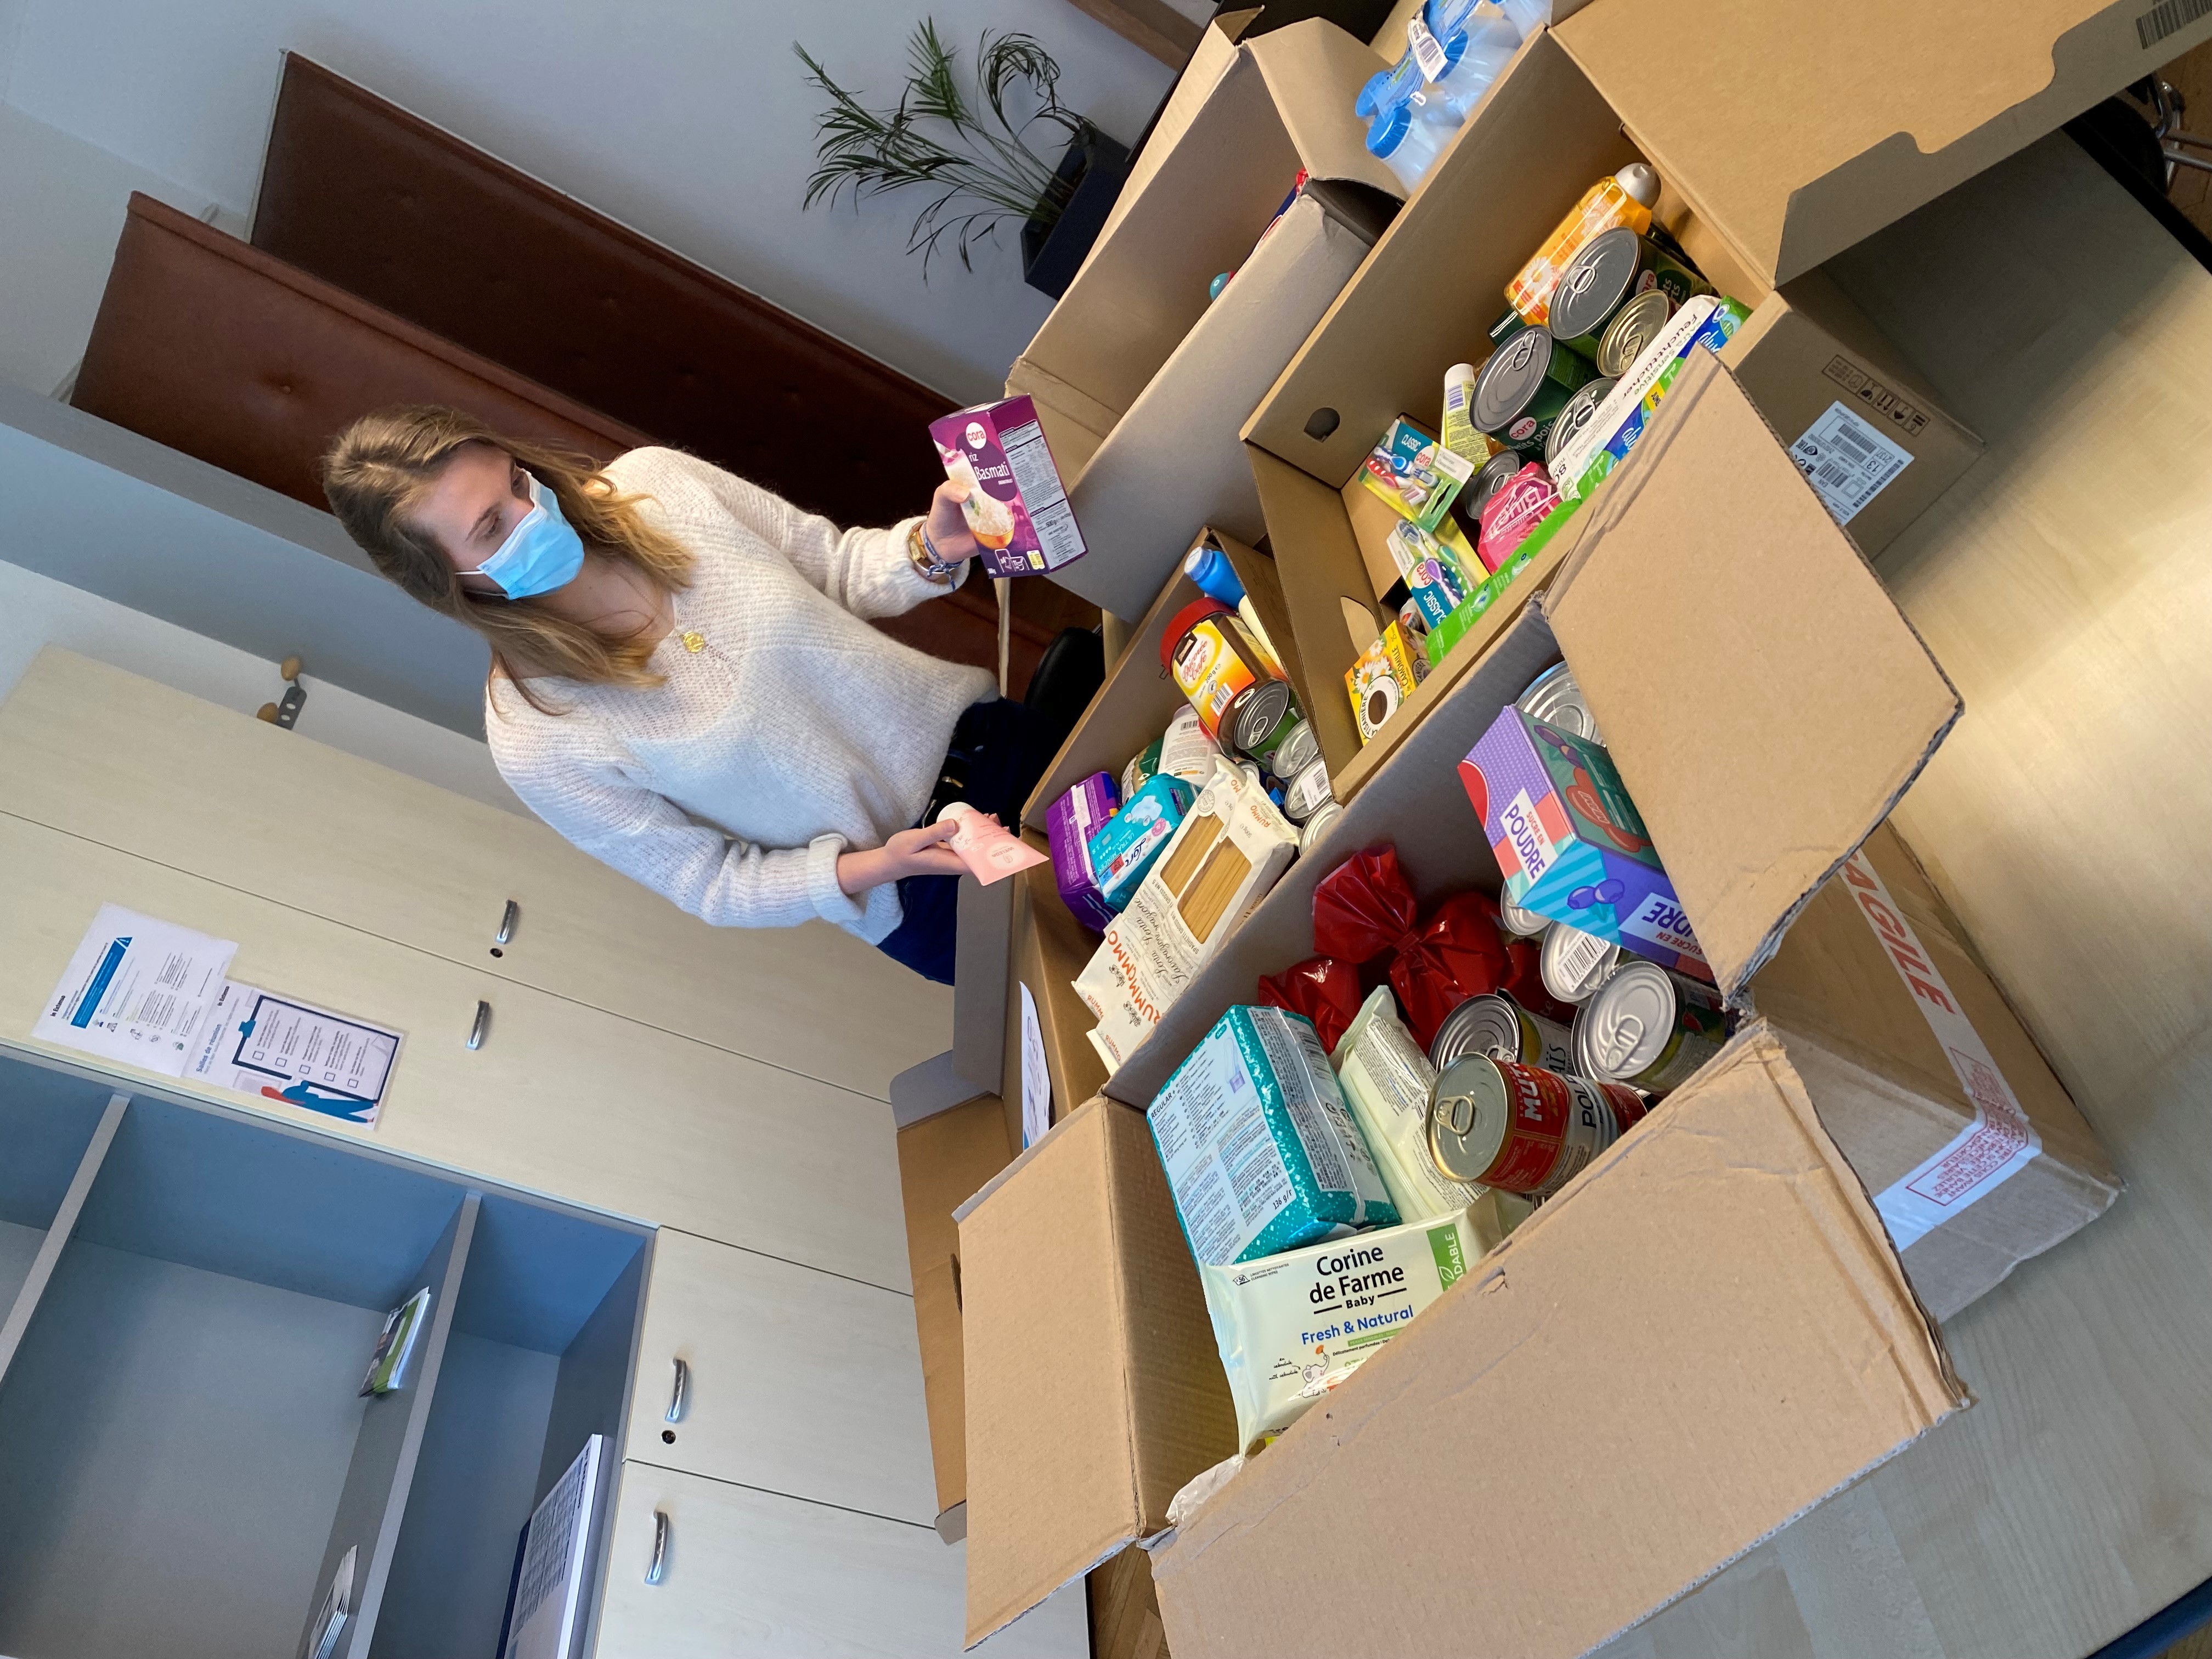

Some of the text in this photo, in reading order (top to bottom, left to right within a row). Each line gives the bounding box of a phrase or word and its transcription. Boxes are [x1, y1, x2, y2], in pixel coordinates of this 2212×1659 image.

[1621, 313, 1697, 400] Feuchttücher
[966, 428, 985, 443] cora
[1510, 419, 1535, 437] cora
[1533, 421, 1554, 442] pois
[1401, 433, 1421, 452] CLASSIC
[969, 452, 979, 462] riz
[1415, 451, 1431, 466] cora
[1865, 459, 1880, 474] 13
[1875, 449, 1892, 463] 2137
[974, 461, 1010, 481] Basmati
[1817, 478, 1829, 488] EAN
[1416, 563, 1429, 585] cora
[1392, 645, 1408, 686] CAMOMILLE
[1205, 673, 1213, 683] 200
[1230, 780, 1241, 795] MO
[1250, 804, 1271, 827] RUMMO
[1526, 811, 1545, 845] SUCRE EN
[1504, 804, 1547, 879] POUDRE
[1097, 832, 1135, 873] ULTRA MINCES
[1159, 888, 1171, 903] GROSSI
[1136, 917, 1153, 945] Lenta
[1655, 931, 1672, 943] EN
[1844, 851, 1955, 1015] AGILE
[1181, 932, 1199, 954] SPAGHETTI
[1151, 950, 1169, 979] Lenta
[53, 994, 65, 1012] Extenso
[196, 1023, 222, 1073] Salles de réunion
[1105, 1035, 1121, 1061] RUMMO
[1545, 1043, 1565, 1074] AÏS
[1509, 1062, 1541, 1120] MUT
[1150, 1092, 1173, 1119] REGULAR
[1931, 1167, 1966, 1192] VEUILLEZ
[1963, 1160, 1987, 1178] CETTE
[1946, 1177, 1973, 1198] AVANT
[1272, 1197, 1283, 1210] 136
[1316, 1244, 1385, 1276] Corine
[1310, 1264, 1405, 1305] de Farme
[1346, 1294, 1375, 1310] Baby
[1301, 1306, 1414, 1345] Fresh & Natural
[1333, 1346, 1356, 1356] Délicatement
[1357, 1340, 1380, 1351] parfumées
